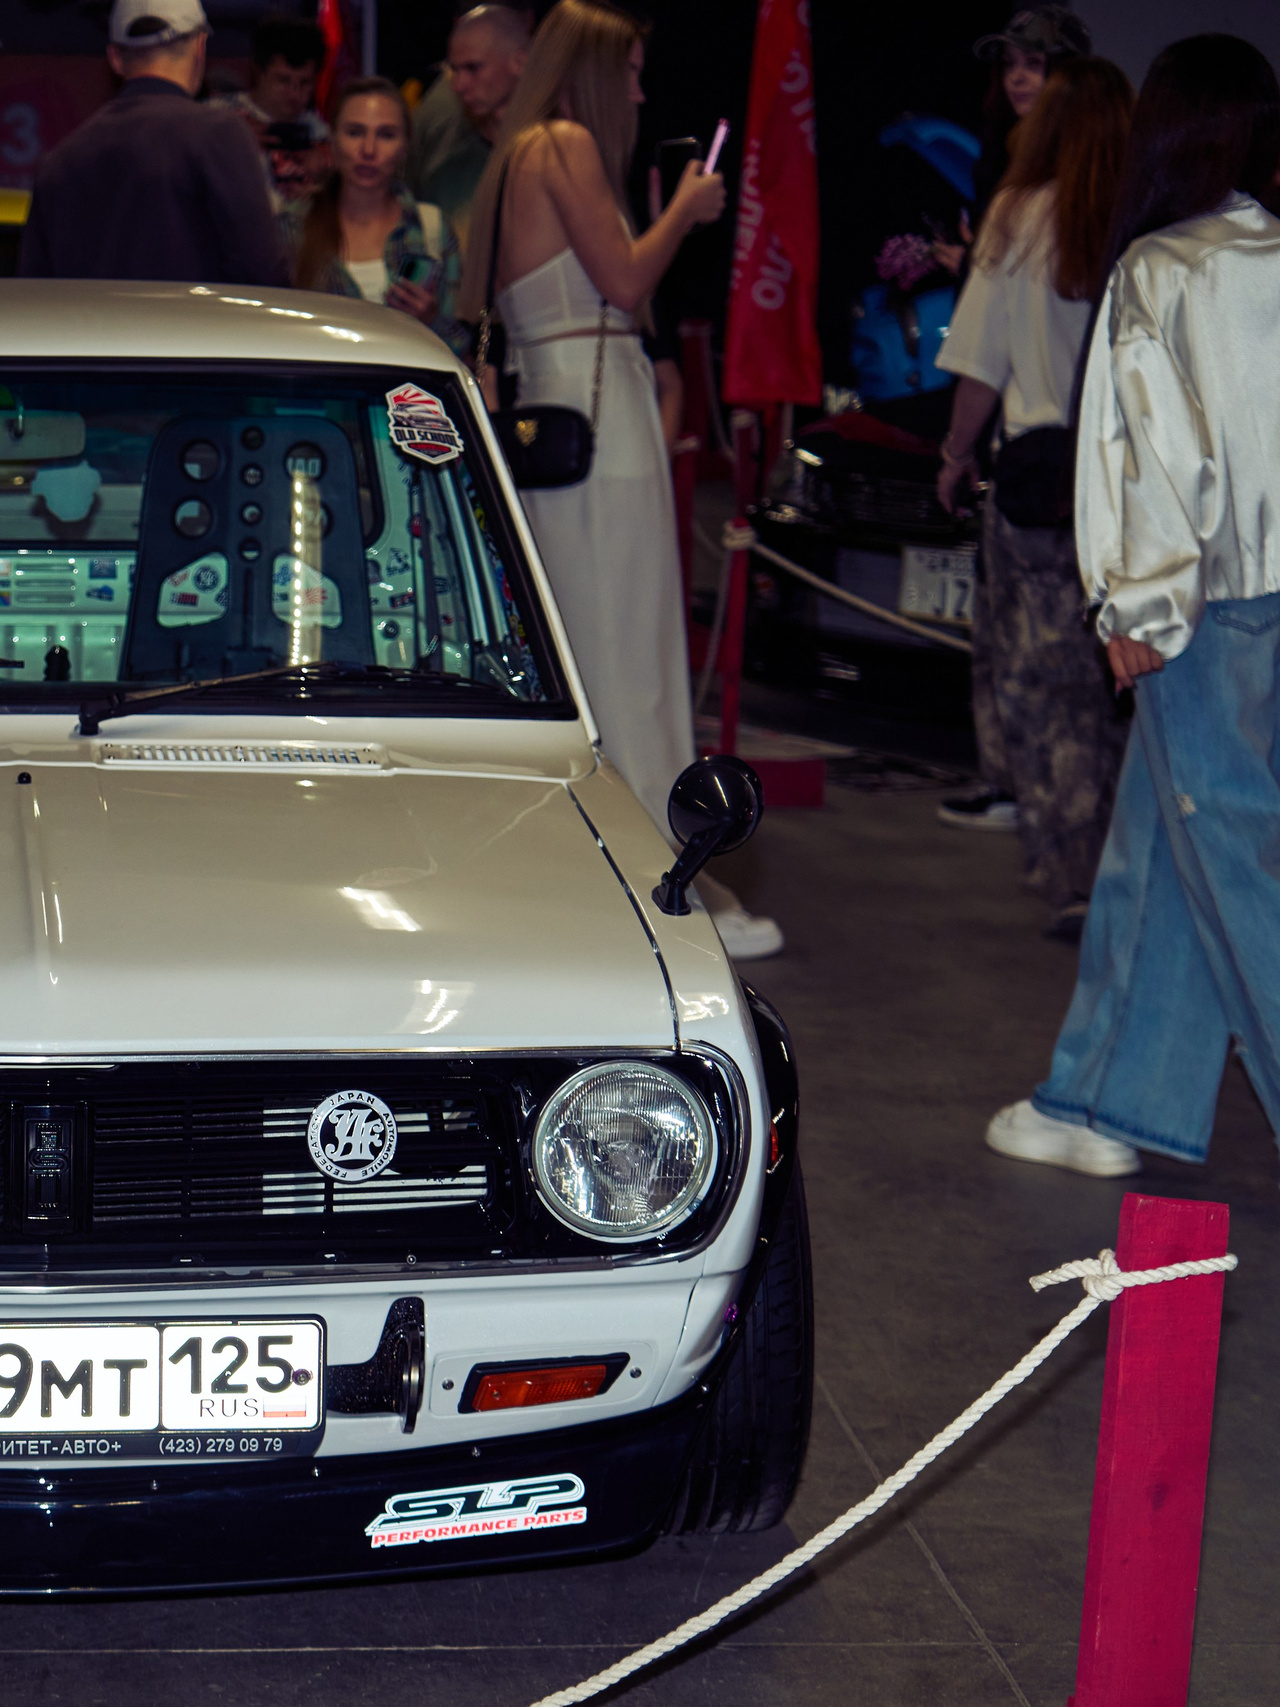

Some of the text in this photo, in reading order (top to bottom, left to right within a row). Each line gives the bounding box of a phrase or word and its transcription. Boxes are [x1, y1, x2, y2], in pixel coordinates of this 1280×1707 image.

[0, 101, 44, 166] 3
[394, 429, 458, 447] OLD SCHOOL
[329, 1092, 375, 1106] JAPAN
[361, 1112, 395, 1177] AUTOMOBILE
[168, 1335, 294, 1395] 125
[199, 1398, 259, 1418] RUS
[158, 1437, 283, 1455] (423) 279 09 79
[373, 1510, 585, 1546] PERFORMANCE PARTS
